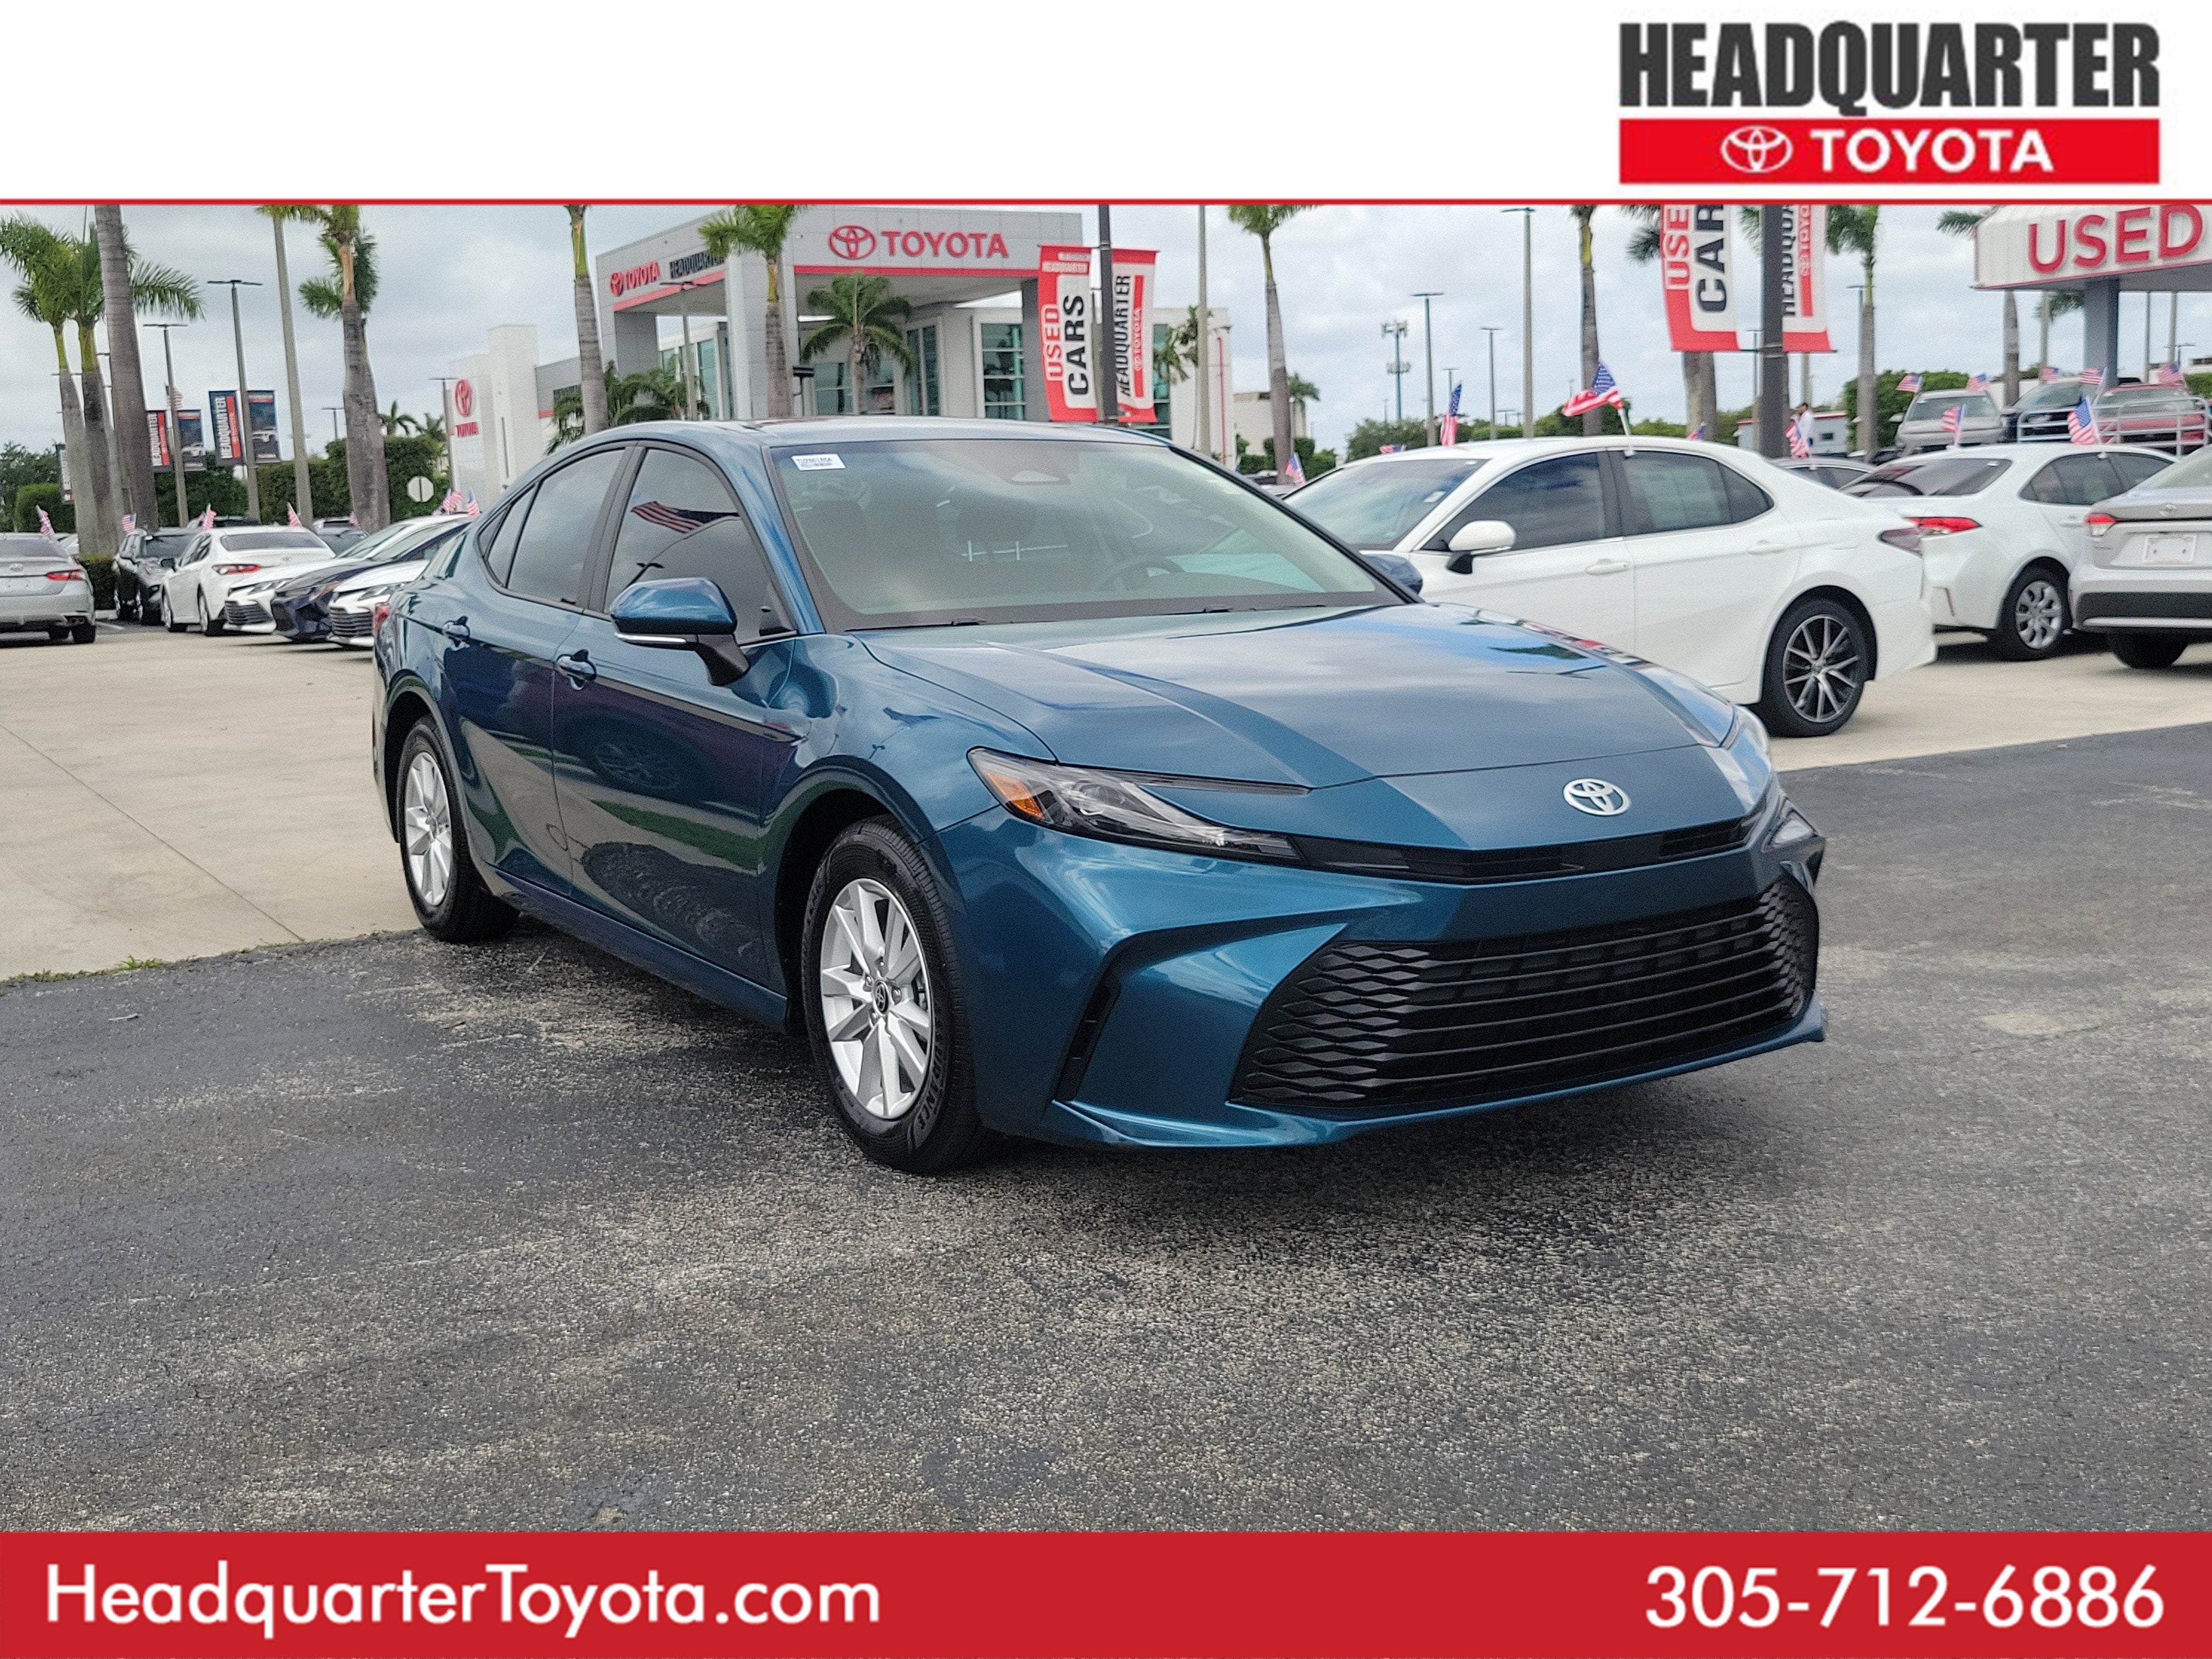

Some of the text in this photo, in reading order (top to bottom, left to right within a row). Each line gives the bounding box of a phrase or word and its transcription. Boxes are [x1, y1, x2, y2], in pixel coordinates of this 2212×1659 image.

[881, 230, 1009, 258] TOYOTA
[2028, 204, 2203, 274] USED
[625, 261, 660, 290] TOYOTA
[1045, 307, 1063, 378] USED
[1063, 295, 1089, 395] CARS
